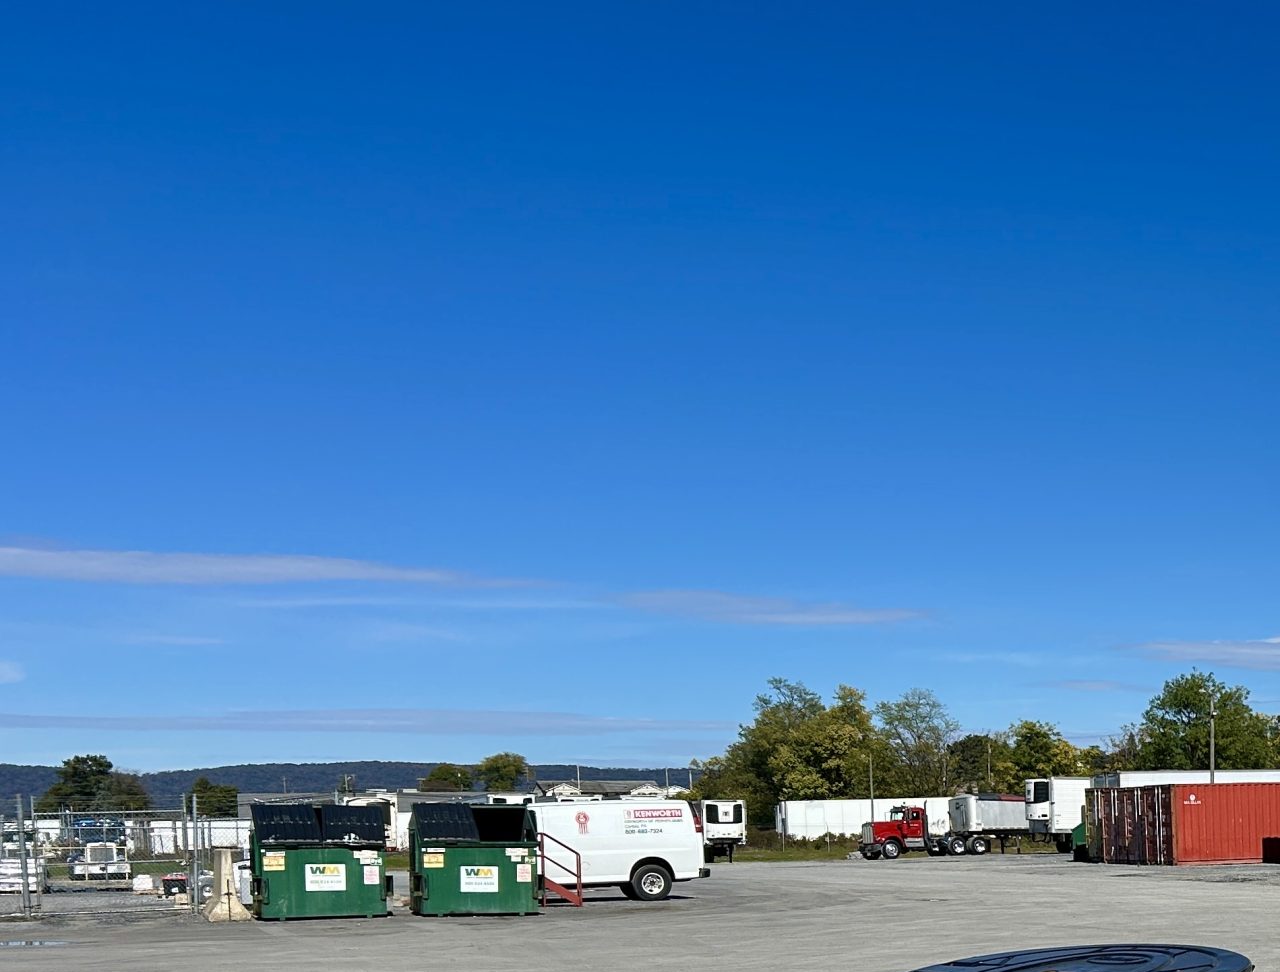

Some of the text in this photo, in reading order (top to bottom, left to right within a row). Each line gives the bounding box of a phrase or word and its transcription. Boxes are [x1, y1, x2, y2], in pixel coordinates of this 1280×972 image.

[634, 809, 682, 818] KENWORTH
[310, 866, 340, 875] WM
[465, 868, 493, 876] WM
